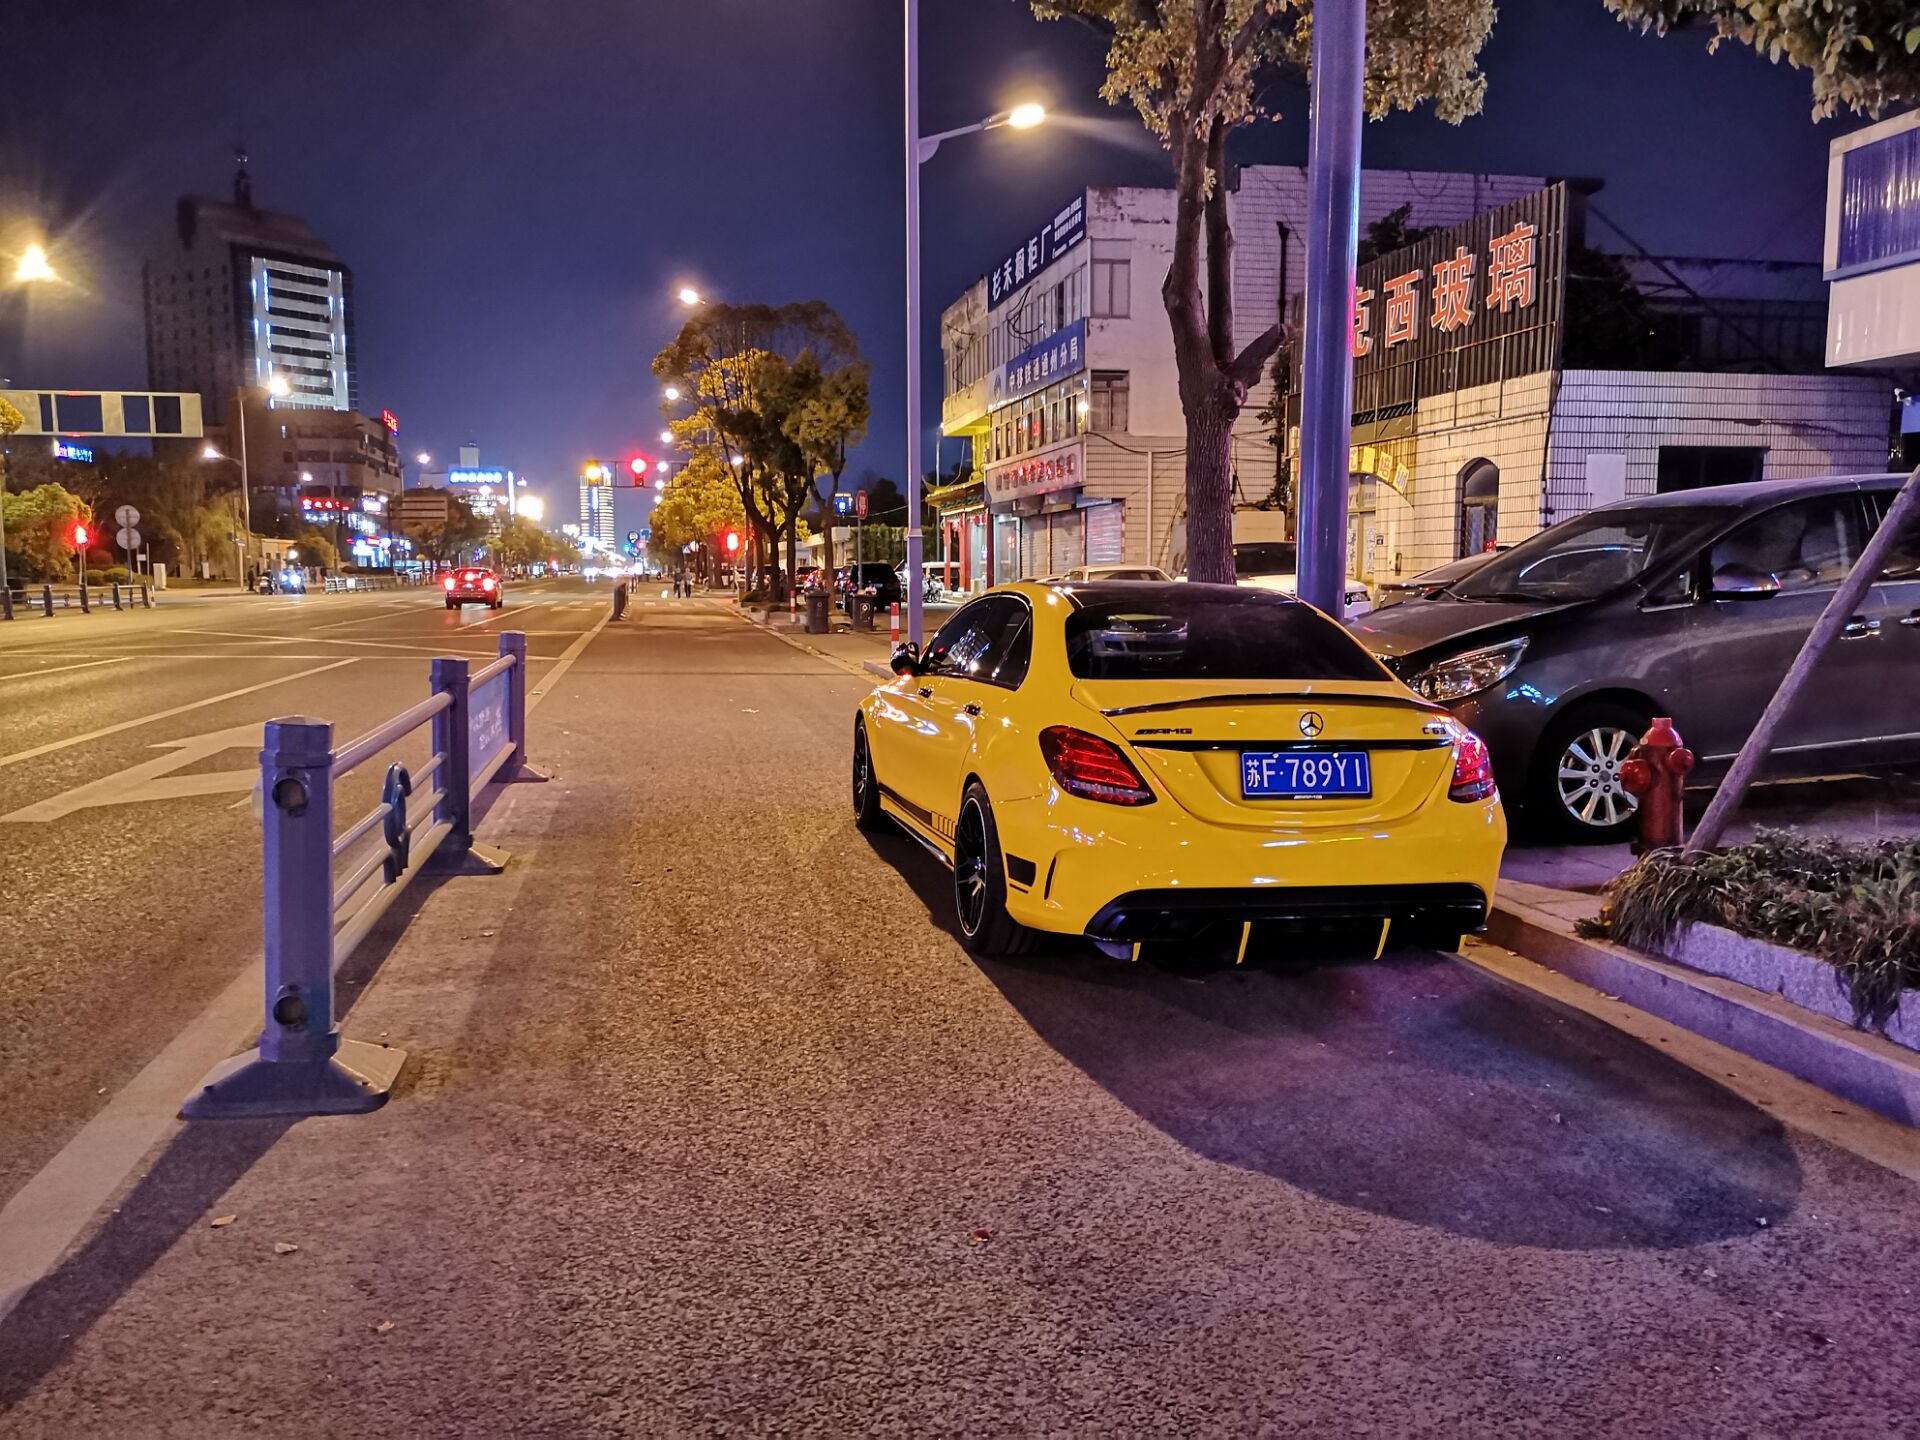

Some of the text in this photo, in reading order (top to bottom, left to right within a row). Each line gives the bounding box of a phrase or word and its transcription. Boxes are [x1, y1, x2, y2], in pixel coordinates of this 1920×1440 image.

[1009, 336, 1078, 392] 中移铁通通州分局
